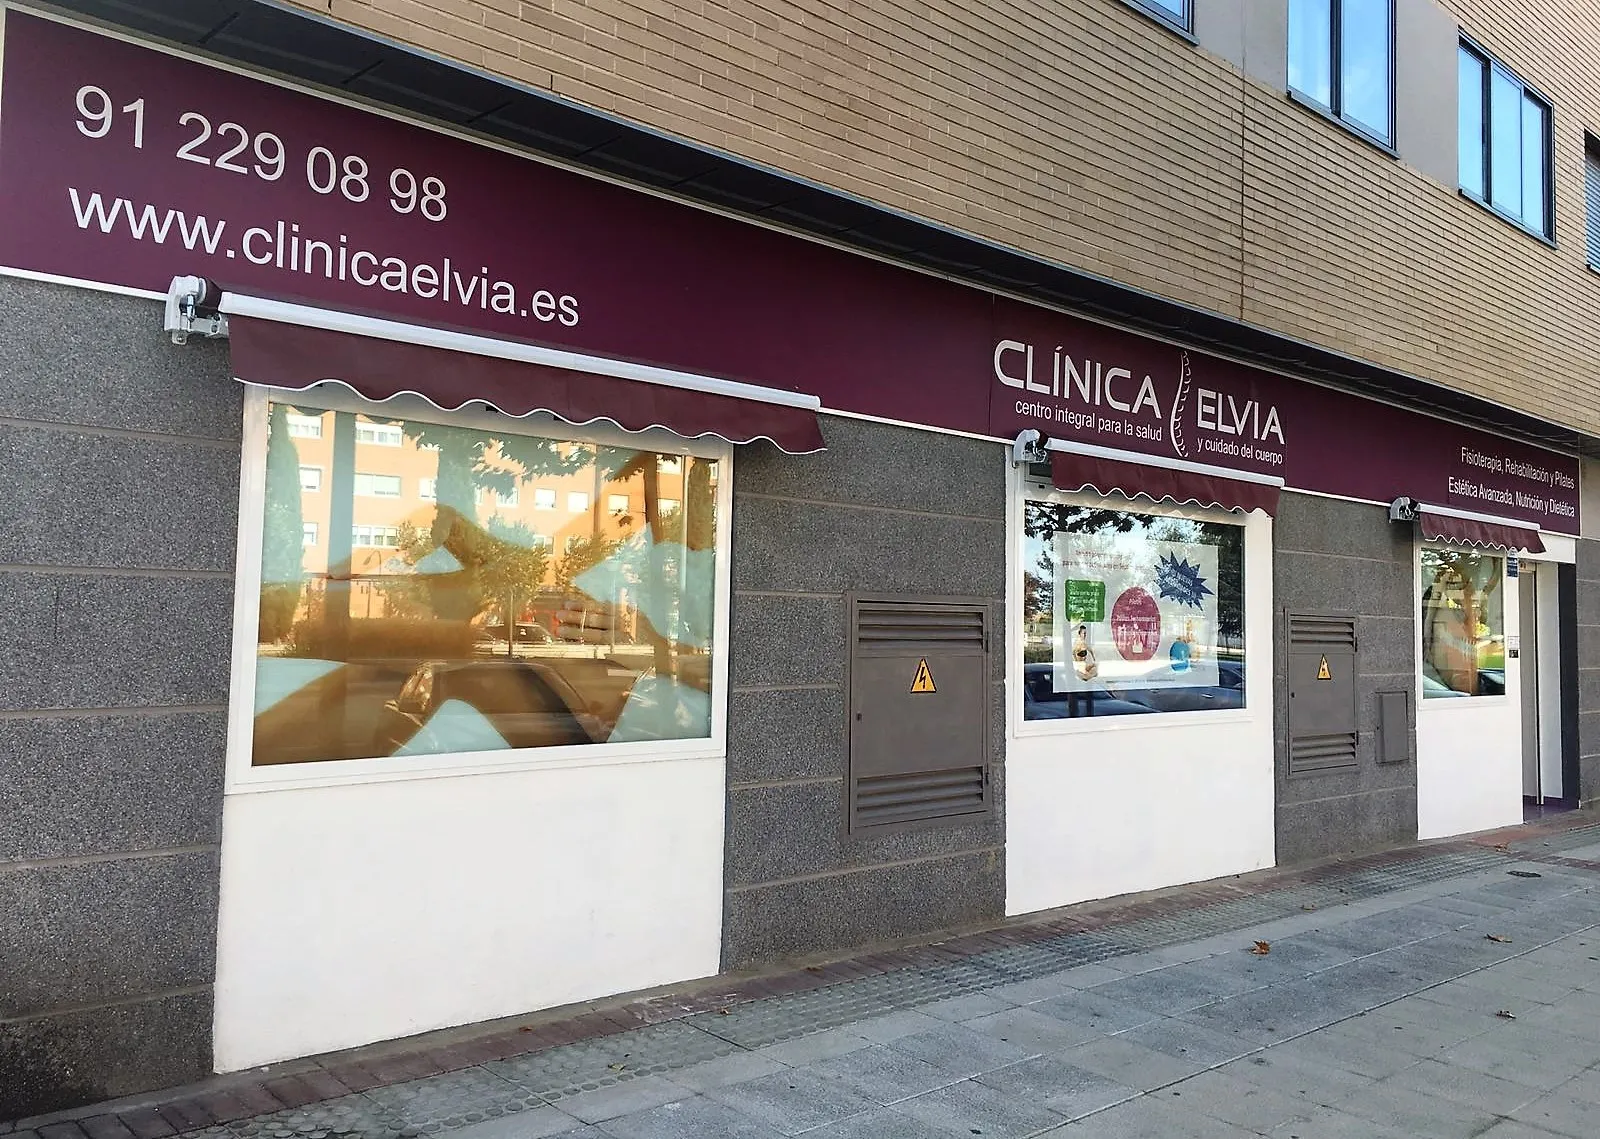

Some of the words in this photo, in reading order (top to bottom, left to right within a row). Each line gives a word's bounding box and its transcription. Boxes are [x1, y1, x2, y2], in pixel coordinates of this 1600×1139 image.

[75, 85, 146, 150] 91
[175, 111, 286, 181] 229
[306, 146, 371, 203] 08
[389, 168, 448, 222] 98
[69, 187, 580, 327] www.clinicaelvia.es
[993, 339, 1162, 419] CLÍNICA
[1197, 387, 1285, 445] ELVIA
[1015, 400, 1052, 420] centro
[1055, 405, 1095, 430] integral
[1098, 417, 1122, 435] para
[1124, 419, 1133, 436] la
[1136, 423, 1162, 442] salud
[1197, 438, 1204, 453] y
[1205, 437, 1239, 457] cuidado
[1240, 443, 1253, 459] del
[1254, 449, 1283, 466] cuerpo
[1461, 446, 1504, 475] Fisioterapia,
[1505, 457, 1549, 483] Rehabilitación
[1549, 474, 1554, 487] y
[1554, 470, 1575, 490] Pilates
[1448, 476, 1478, 499] Estética
[1478, 483, 1515, 507] Avanzada,
[1516, 490, 1543, 511] Nutrición
[1544, 501, 1549, 516] y
[1549, 498, 1575, 518] Dietética
